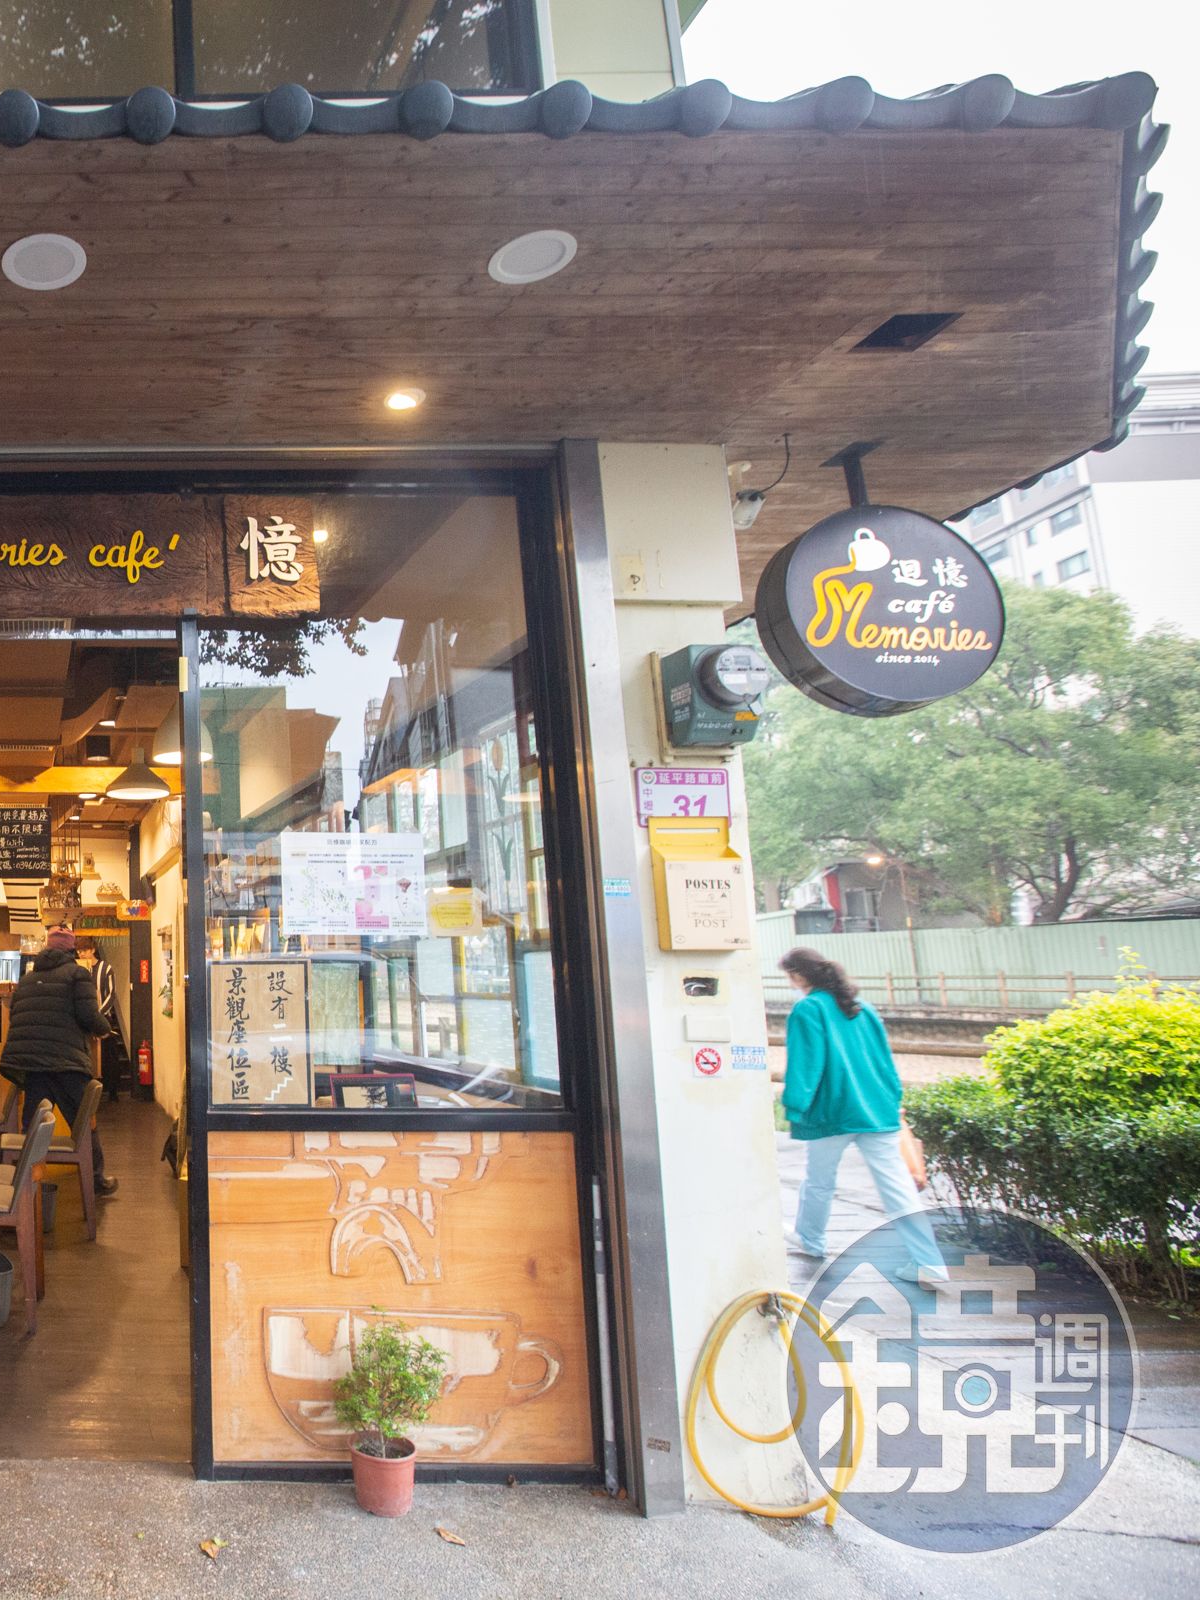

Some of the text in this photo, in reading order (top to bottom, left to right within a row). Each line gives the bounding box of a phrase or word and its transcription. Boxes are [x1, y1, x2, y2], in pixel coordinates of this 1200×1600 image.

[240, 516, 305, 582] 憶
[890, 556, 968, 588] 迴憶
[806, 578, 993, 652] Memories
[887, 590, 957, 624] café
[875, 652, 941, 666] since 2014
[671, 794, 708, 816] 31
[685, 879, 731, 889] POSTES
[693, 919, 728, 928] POST
[225, 967, 251, 1100] 景觀座位區
